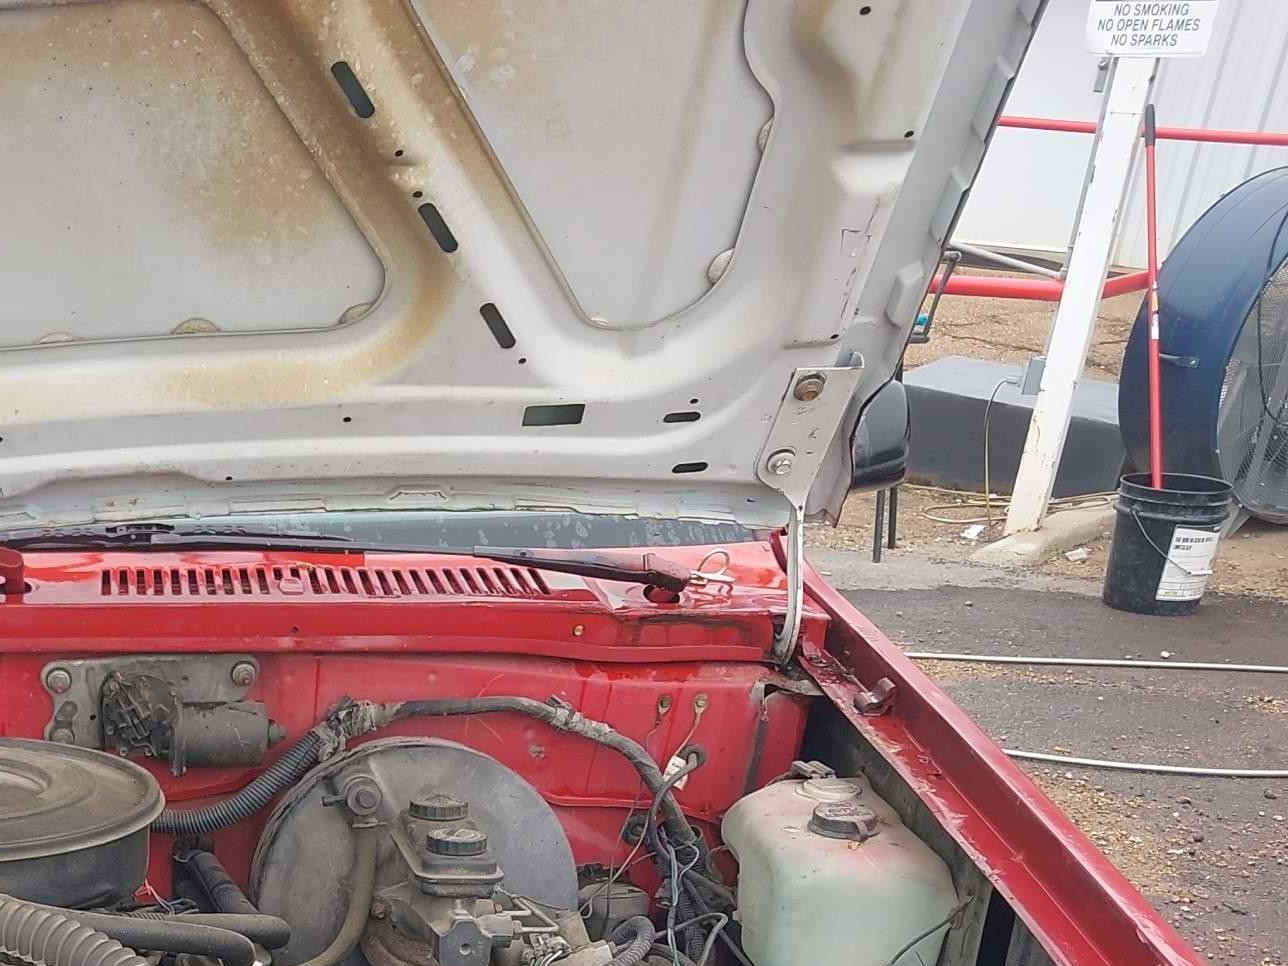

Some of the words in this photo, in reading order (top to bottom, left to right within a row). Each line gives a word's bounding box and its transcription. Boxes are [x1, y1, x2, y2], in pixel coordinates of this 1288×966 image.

[1114, 3, 1131, 16] NO
[1134, 3, 1190, 16] SMOKING
[1097, 18, 1113, 31] NO
[1117, 18, 1149, 31] OPEN
[1151, 18, 1201, 31] FLAMES
[1111, 34, 1128, 46] NO
[1130, 33, 1178, 46] SPARKS
